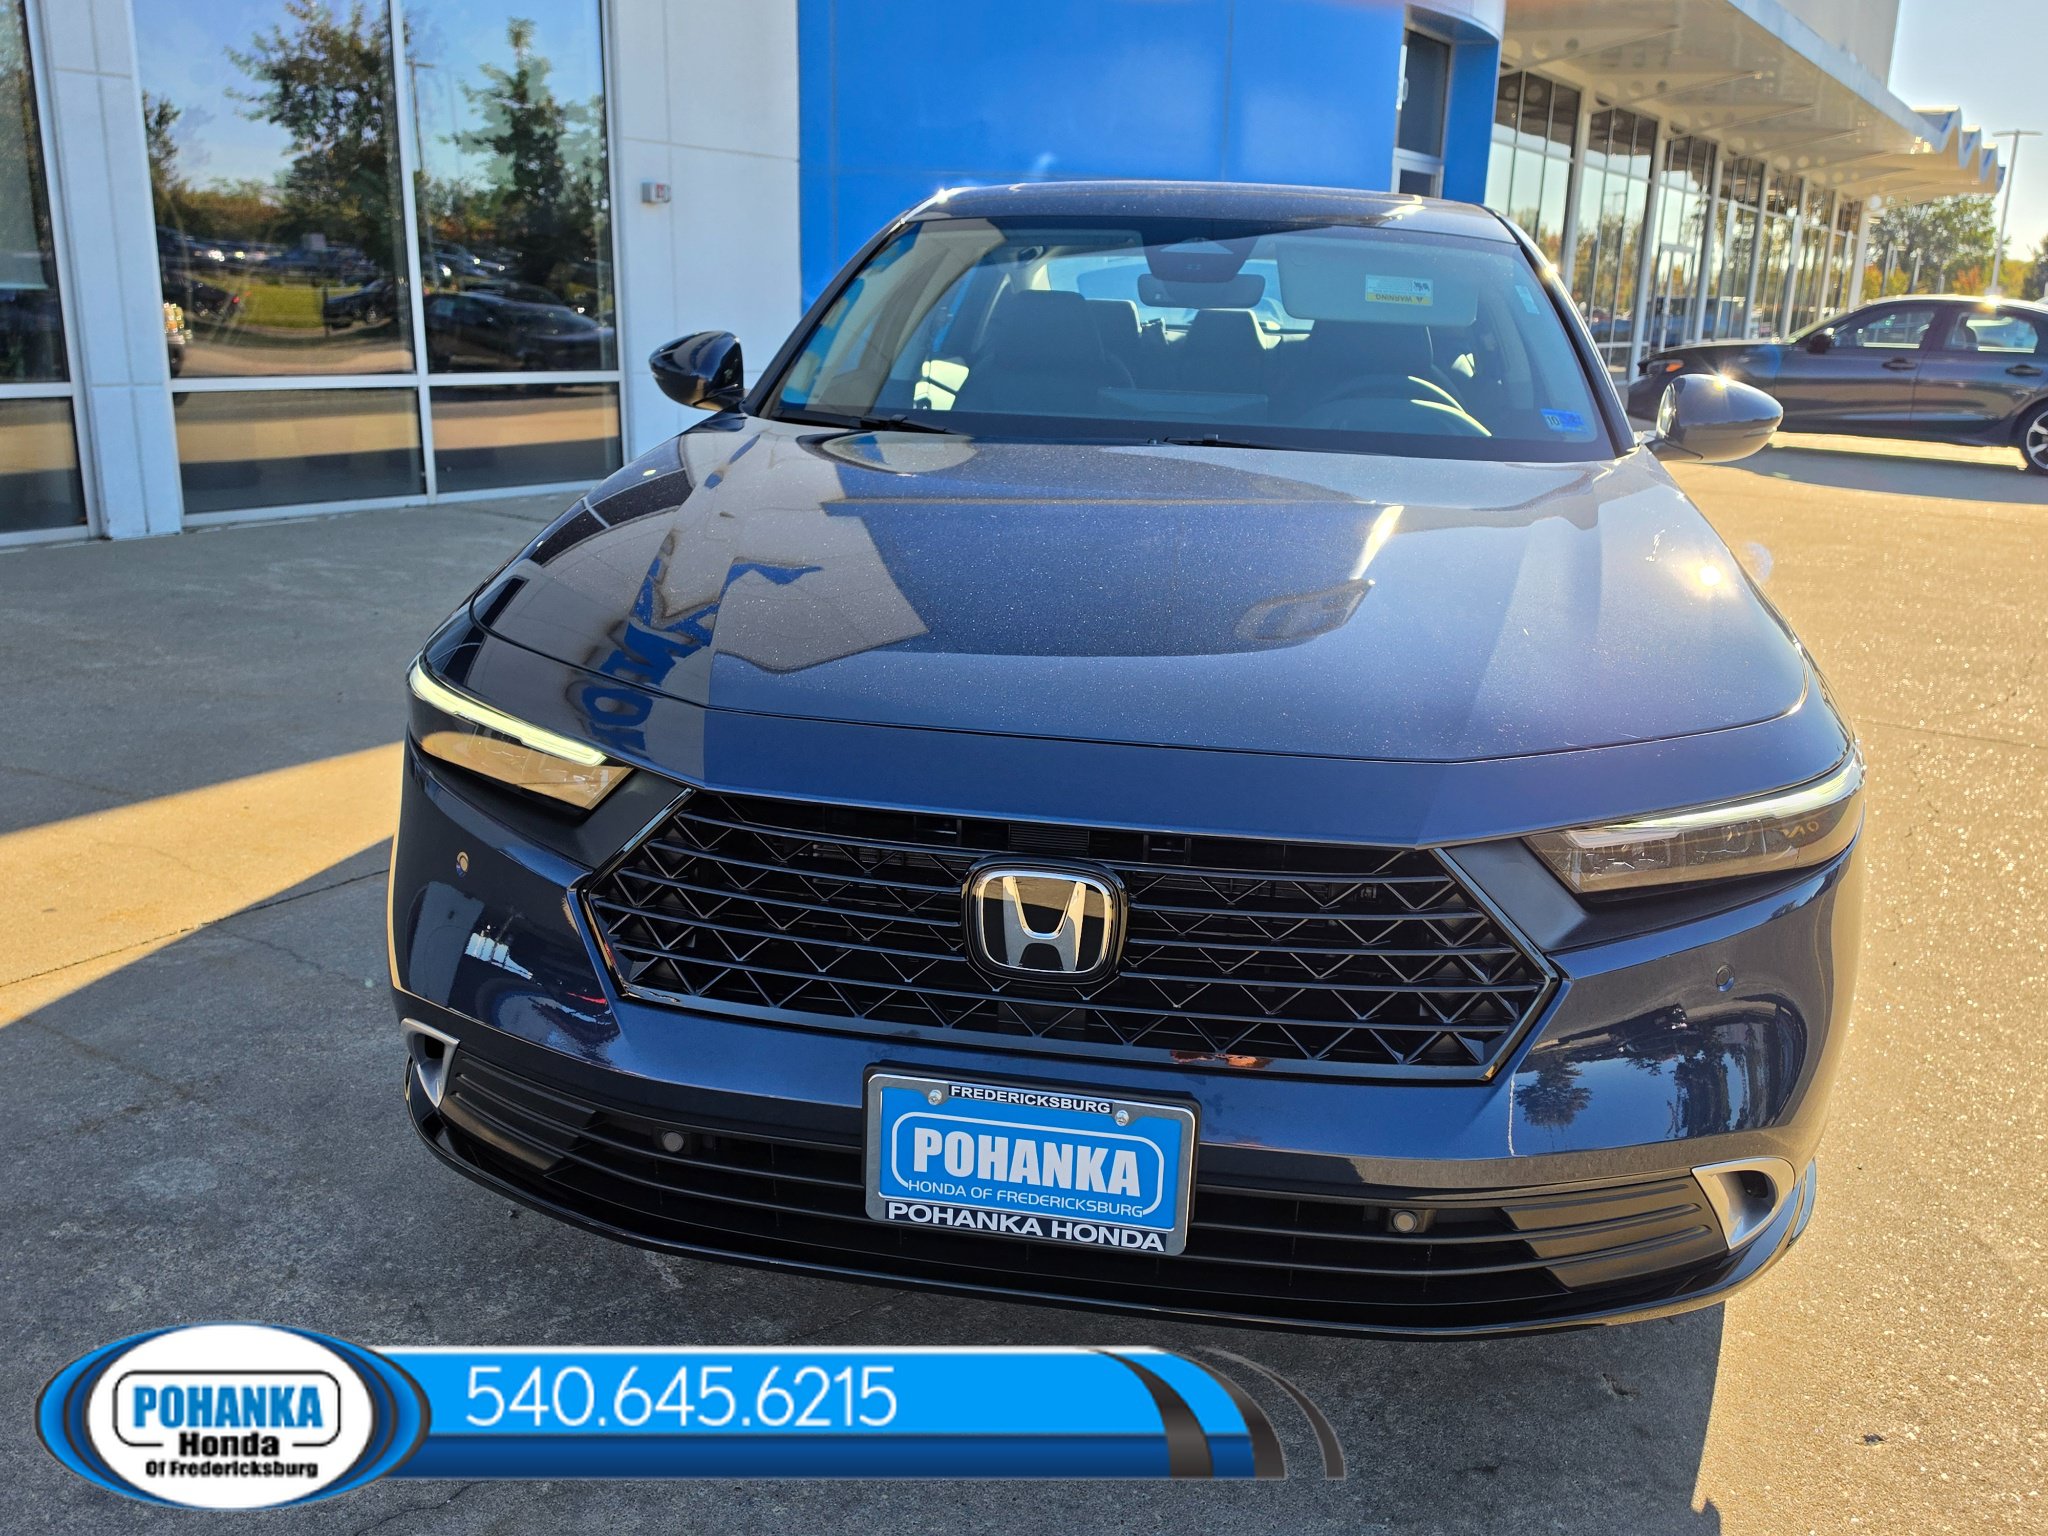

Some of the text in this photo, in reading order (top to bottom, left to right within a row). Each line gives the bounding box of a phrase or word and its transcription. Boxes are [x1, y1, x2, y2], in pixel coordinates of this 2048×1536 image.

[1375, 293, 1412, 303] WARNING
[950, 1085, 1111, 1114] FREDERICKSBURG
[913, 1127, 1140, 1197] POHANKA
[908, 1179, 1144, 1218] HONDA OF FREDERICKSBURG
[888, 1202, 1165, 1252] POHANKA HONDA
